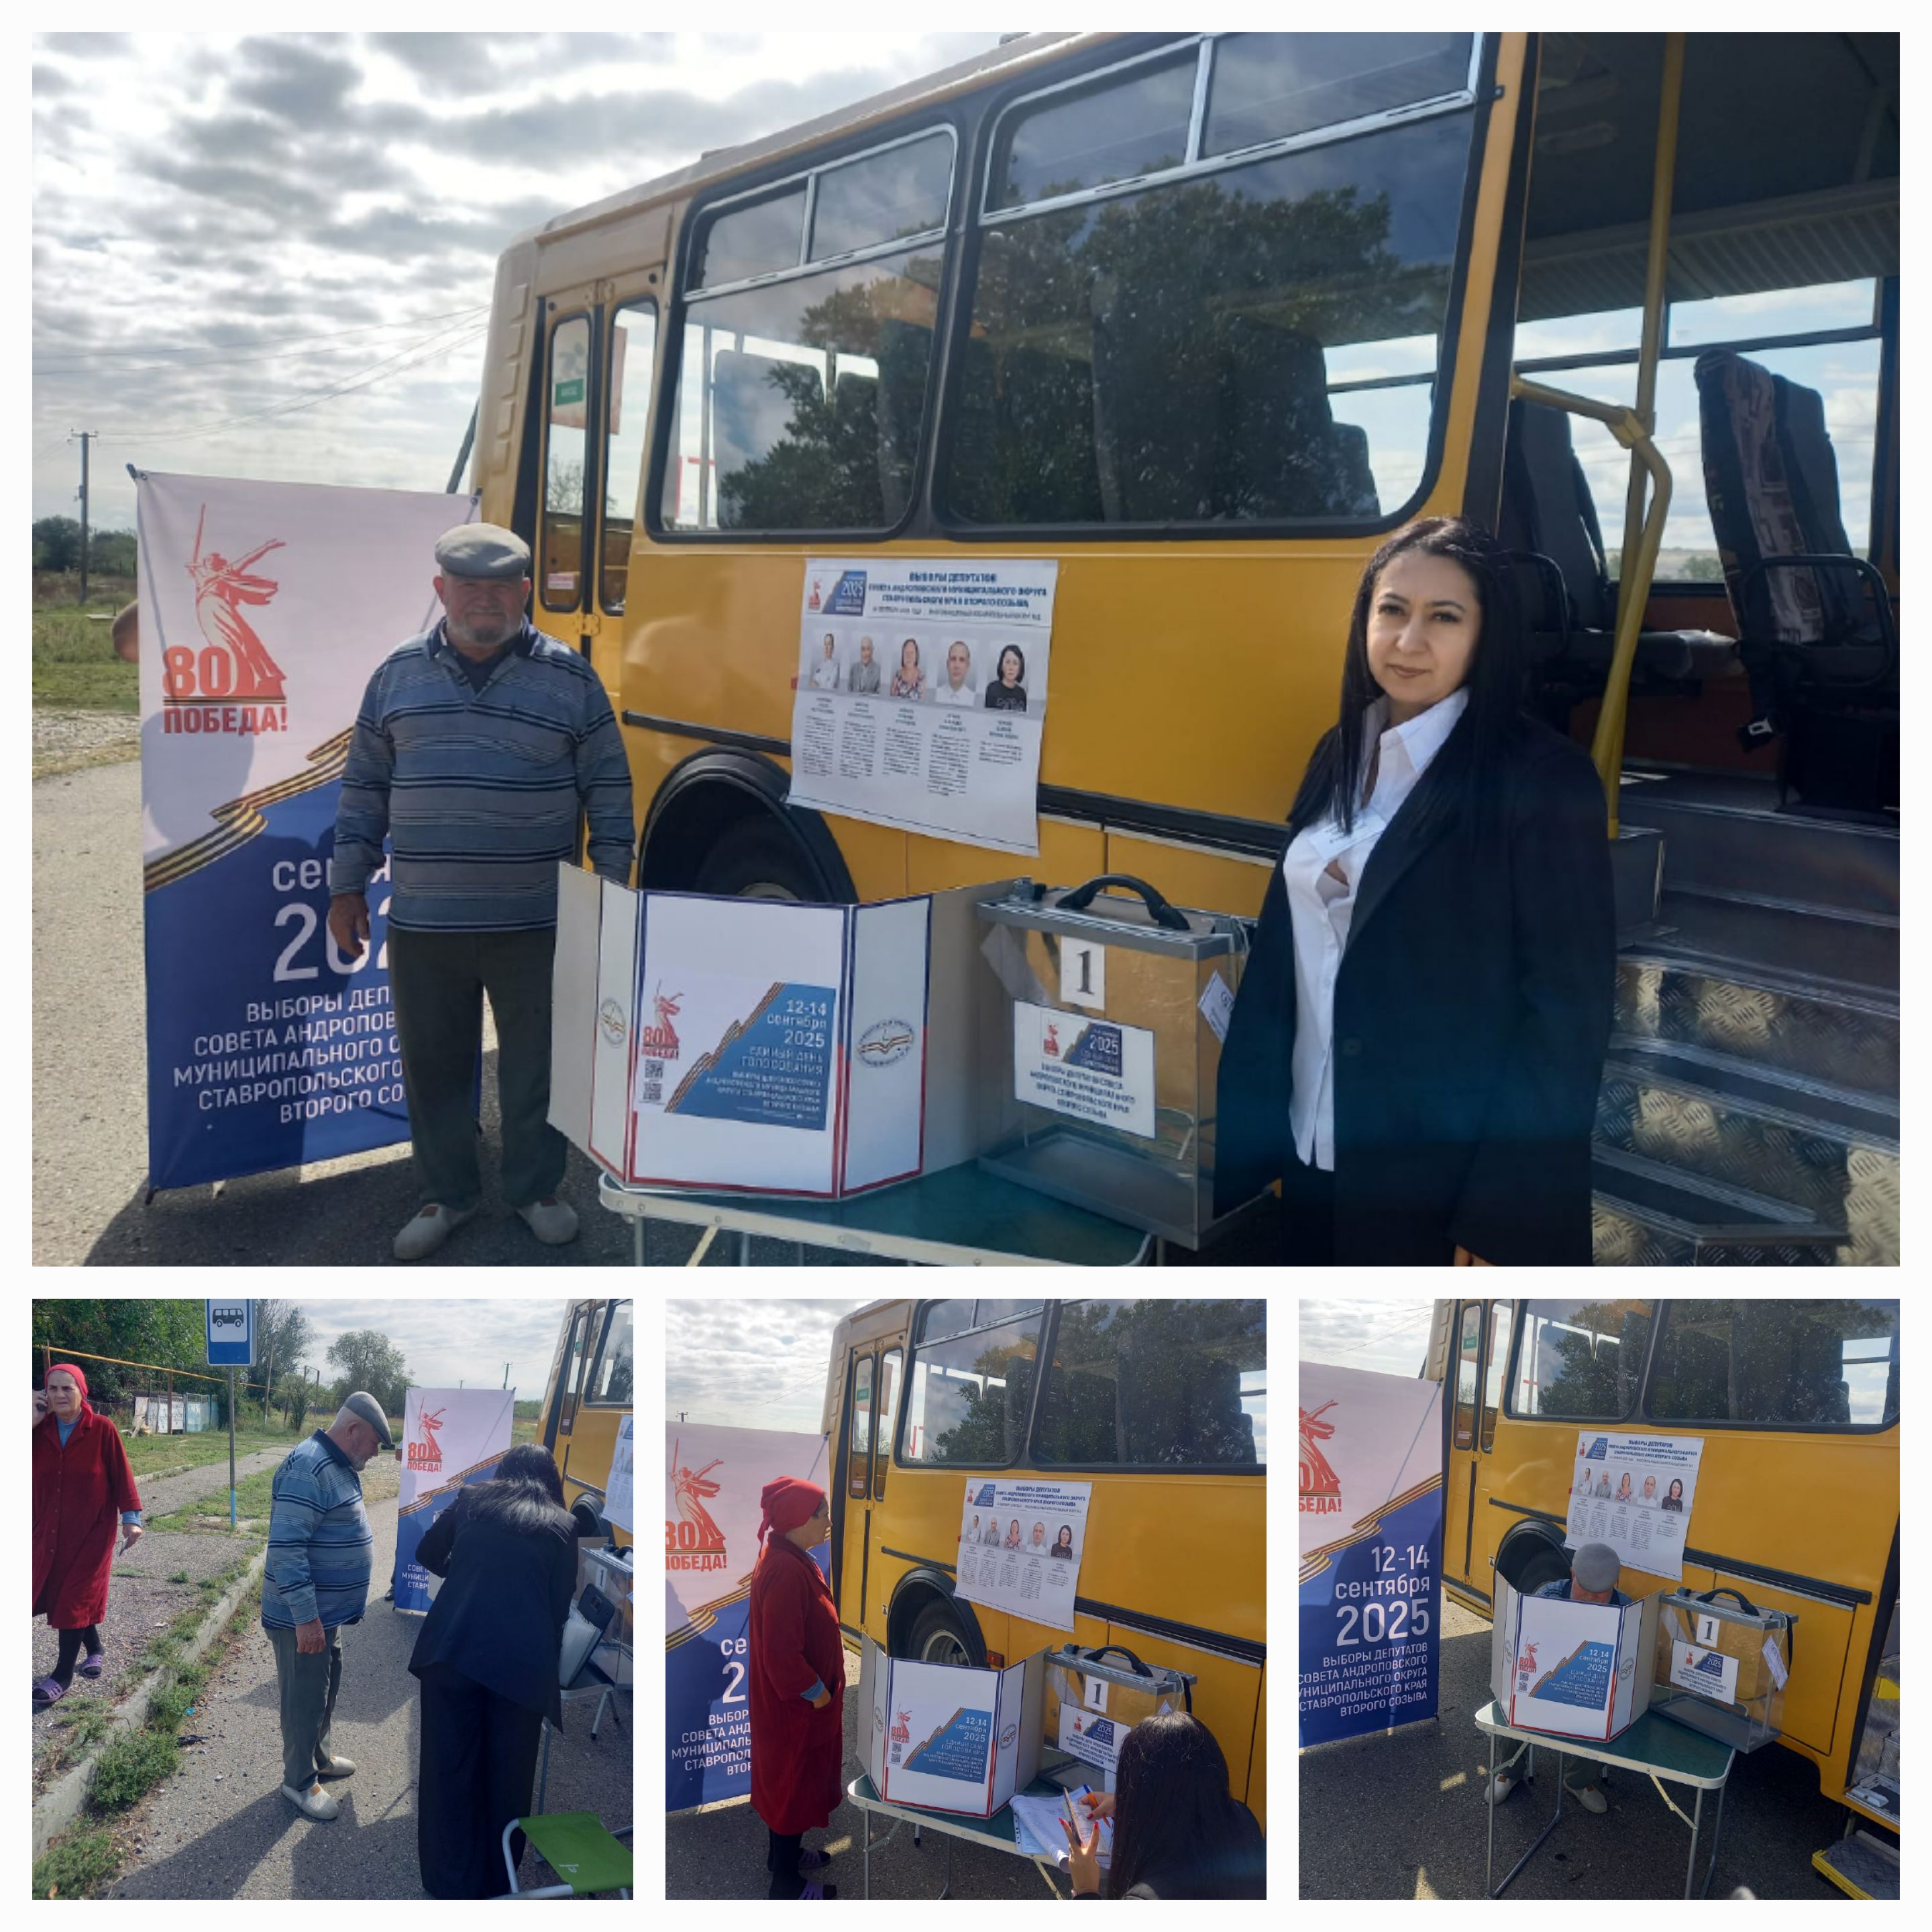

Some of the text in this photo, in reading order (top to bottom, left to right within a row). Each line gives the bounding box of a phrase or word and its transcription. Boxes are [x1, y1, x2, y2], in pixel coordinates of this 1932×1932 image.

[162, 645, 231, 697] 80
[164, 706, 287, 735] ПОБЕДА!
[1077, 950, 1095, 996] 1
[247, 992, 343, 1022] ВЫБОРЫ
[786, 1000, 826, 1016] 12-14
[195, 1028, 278, 1056] СОВЕТА
[785, 1030, 825, 1048] 2025
[1090, 1034, 1119, 1055] 2025
[174, 1038, 383, 1087] МУНИЦИПАЛЬНОГО
[199, 1059, 402, 1110] СТАВРОПОЛЬСКОГО
[280, 1083, 406, 1123] ВТОРОГО СО
[408, 1442, 428, 1460] 80
[407, 1461, 442, 1472] ПОБЕДА!
[1371, 1545, 1430, 1572] 12-14
[1335, 1574, 1430, 1599] сентября
[1336, 1598, 1429, 1646] 2025
[1704, 1621, 1712, 1641] 1
[720, 1638, 747, 1656] се
[1324, 1642, 1428, 1668] ВЫБОРЫ ДЕПУТАТОВ
[1589, 1650, 1609, 1658] 12-14
[1342, 1654, 1428, 1676] АНДРОПОВСКОГО
[1587, 1663, 1607, 1672] 2025
[1707, 1658, 1721, 1668] 2025
[722, 1662, 746, 1704] 2
[1394, 1667, 1427, 1682] ОКРУГА
[1092, 1683, 1102, 1705] 1
[1299, 1678, 1427, 1712] СТАВРОПОЛЬСКОГО КРАЯ
[1341, 1691, 1427, 1717] ВТОРОГО СОЗЫВА
[708, 1709, 749, 1725] ВЫБОР
[966, 1717, 987, 1727] 12-14
[682, 1727, 726, 1743] СОВЕТА
[955, 1724, 987, 1733] сентября
[964, 1732, 985, 1743] 2025
[1097, 1724, 1112, 1735] 2025
[672, 1736, 751, 1760] МУНИЦИПАЛЬ
[685, 1749, 751, 1771] СТАВРОПОЛ
